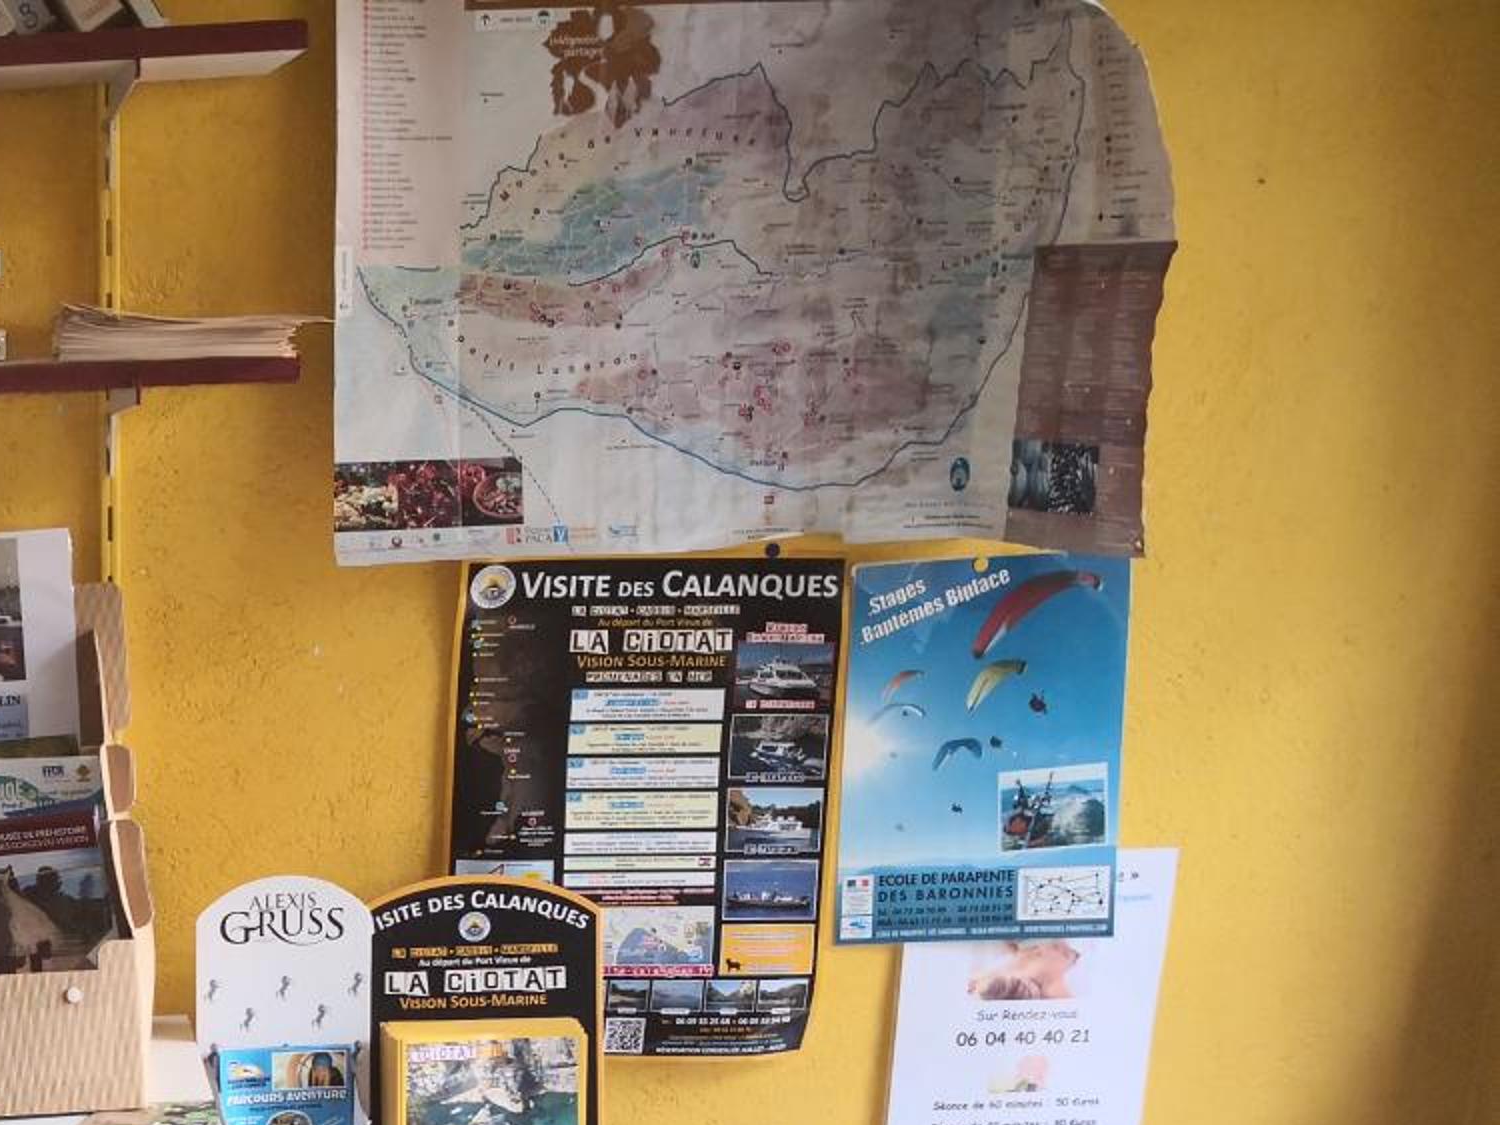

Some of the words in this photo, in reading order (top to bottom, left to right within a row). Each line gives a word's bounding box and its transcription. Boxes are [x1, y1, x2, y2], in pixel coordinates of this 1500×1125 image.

[522, 573, 611, 600] VISITE
[618, 581, 655, 598] DES
[662, 570, 839, 600] CALANQUES
[946, 568, 1012, 607] Biplace
[572, 631, 608, 653] LA
[577, 655, 624, 669] VISION
[627, 653, 726, 668] SOUS-MARINE
[879, 873, 918, 887] ECOLE
[920, 872, 937, 885] DE
[940, 869, 1015, 884] PARAPENTE
[249, 891, 318, 912] ALEXIS
[878, 890, 908, 903] DES
[916, 886, 1013, 901] BARONNIES
[375, 901, 423, 932] ISITE
[427, 893, 466, 913] DES
[470, 889, 591, 930] CALANQUES
[220, 906, 345, 946] GRUSS
[388, 973, 427, 994] LA
[400, 997, 447, 1010] VISION
[450, 993, 548, 1009] SOUS-MARINE
[976, 1009, 999, 1021] Sur
[955, 1031, 978, 1047] 06
[985, 1031, 1007, 1046] 04
[1014, 1030, 1036, 1045] 40
[1042, 1029, 1065, 1044] 40
[1070, 1028, 1090, 1043] 21
[932, 1101, 969, 1112] Séance
[972, 1100, 985, 1110] de
